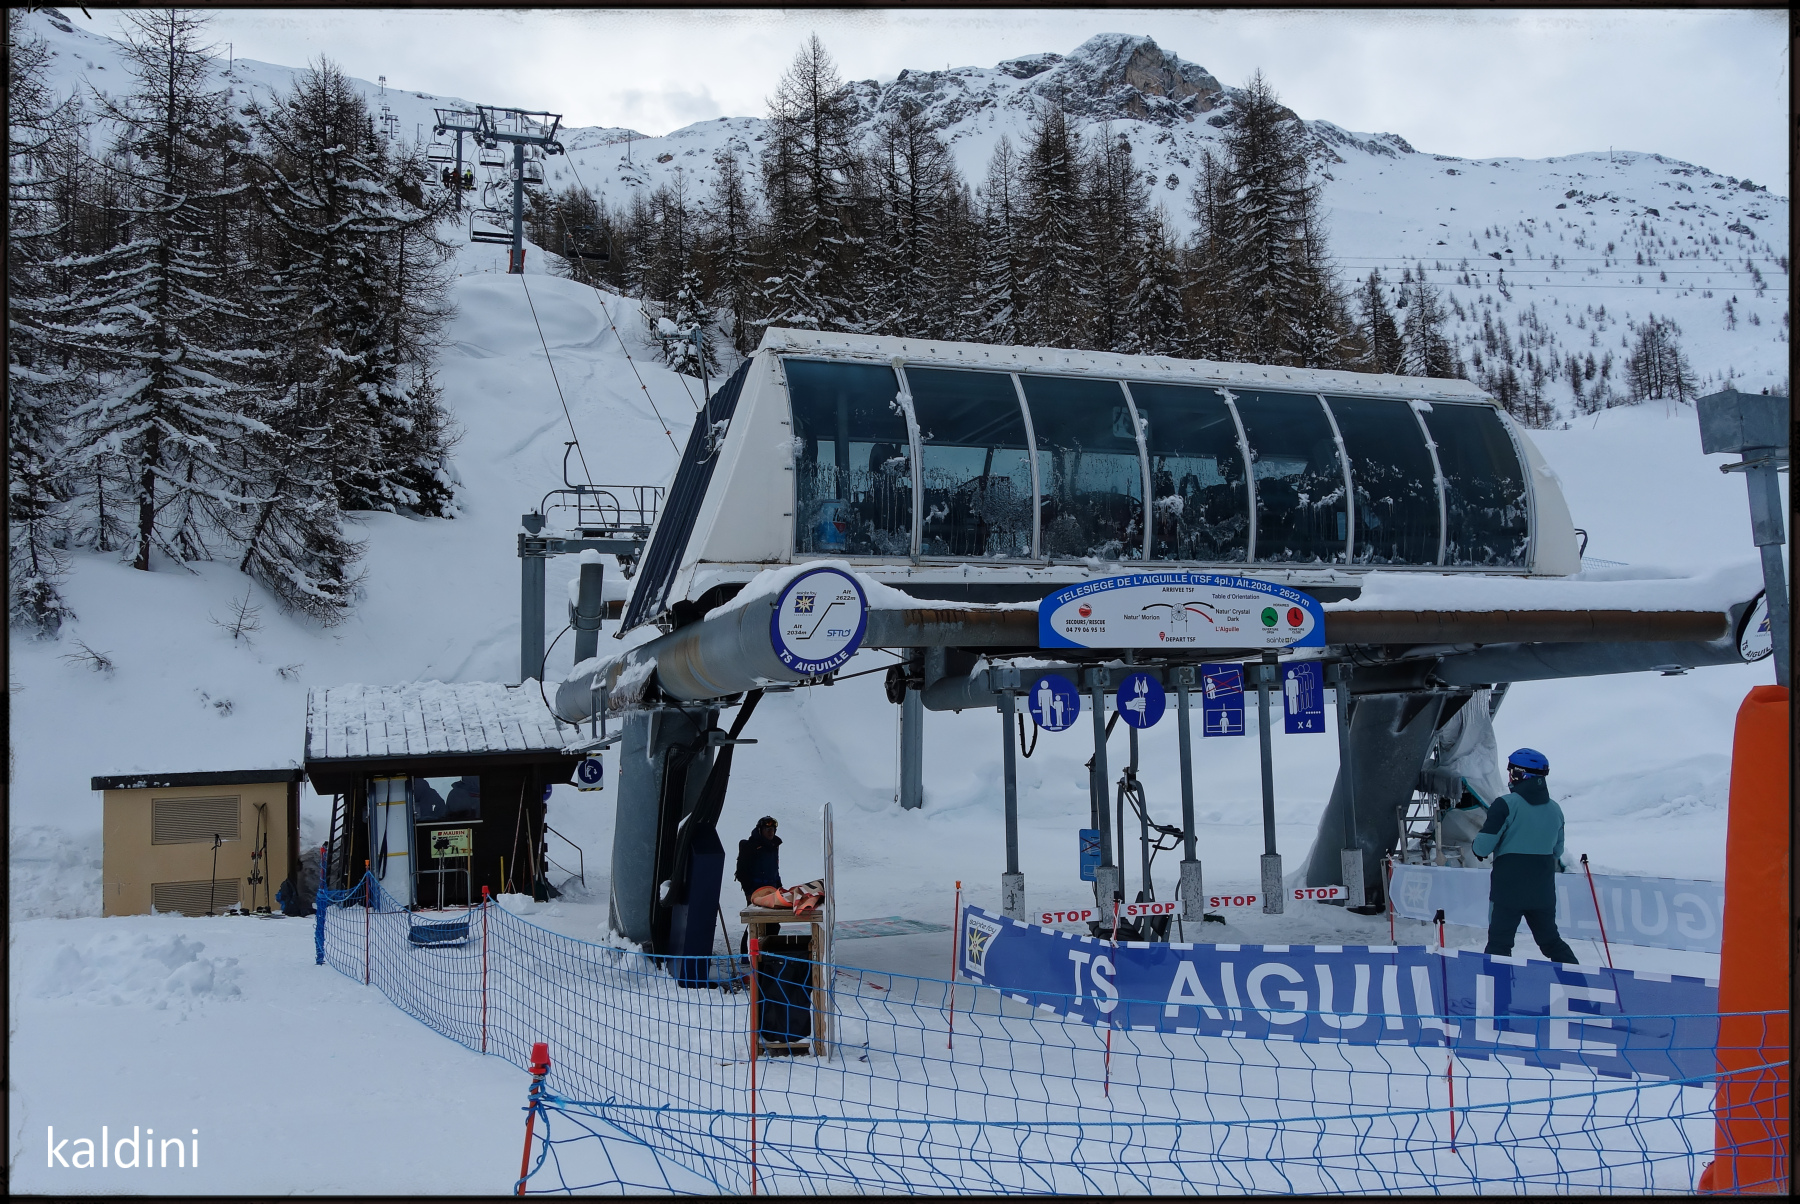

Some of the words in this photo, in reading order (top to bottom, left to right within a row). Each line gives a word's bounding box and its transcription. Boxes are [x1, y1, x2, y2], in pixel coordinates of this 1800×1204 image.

[1056, 580, 1115, 604] TELESIEGE
[1117, 577, 1131, 587] DE
[1133, 574, 1188, 585] L'AIGUILLE
[1190, 574, 1212, 585] (TSF
[1214, 576, 1234, 587] 4pl.)
[1279, 588, 1300, 602] 2622
[1301, 598, 1310, 607] m
[1232, 608, 1251, 616] Crystal
[1746, 646, 1772, 657] AIGUIL
[780, 649, 793, 664] TS
[795, 650, 849, 672] AIGUILLE
[1305, 719, 1312, 729] 4
[1294, 888, 1338, 900] STOP
[1209, 895, 1257, 908] STOP
[1127, 902, 1175, 916] STOP
[1041, 909, 1092, 924] STOP
[969, 919, 986, 930] sainte
[986, 926, 997, 935] foy
[1068, 949, 1119, 1014] TS
[1164, 960, 1617, 1058] AIGUILLE
